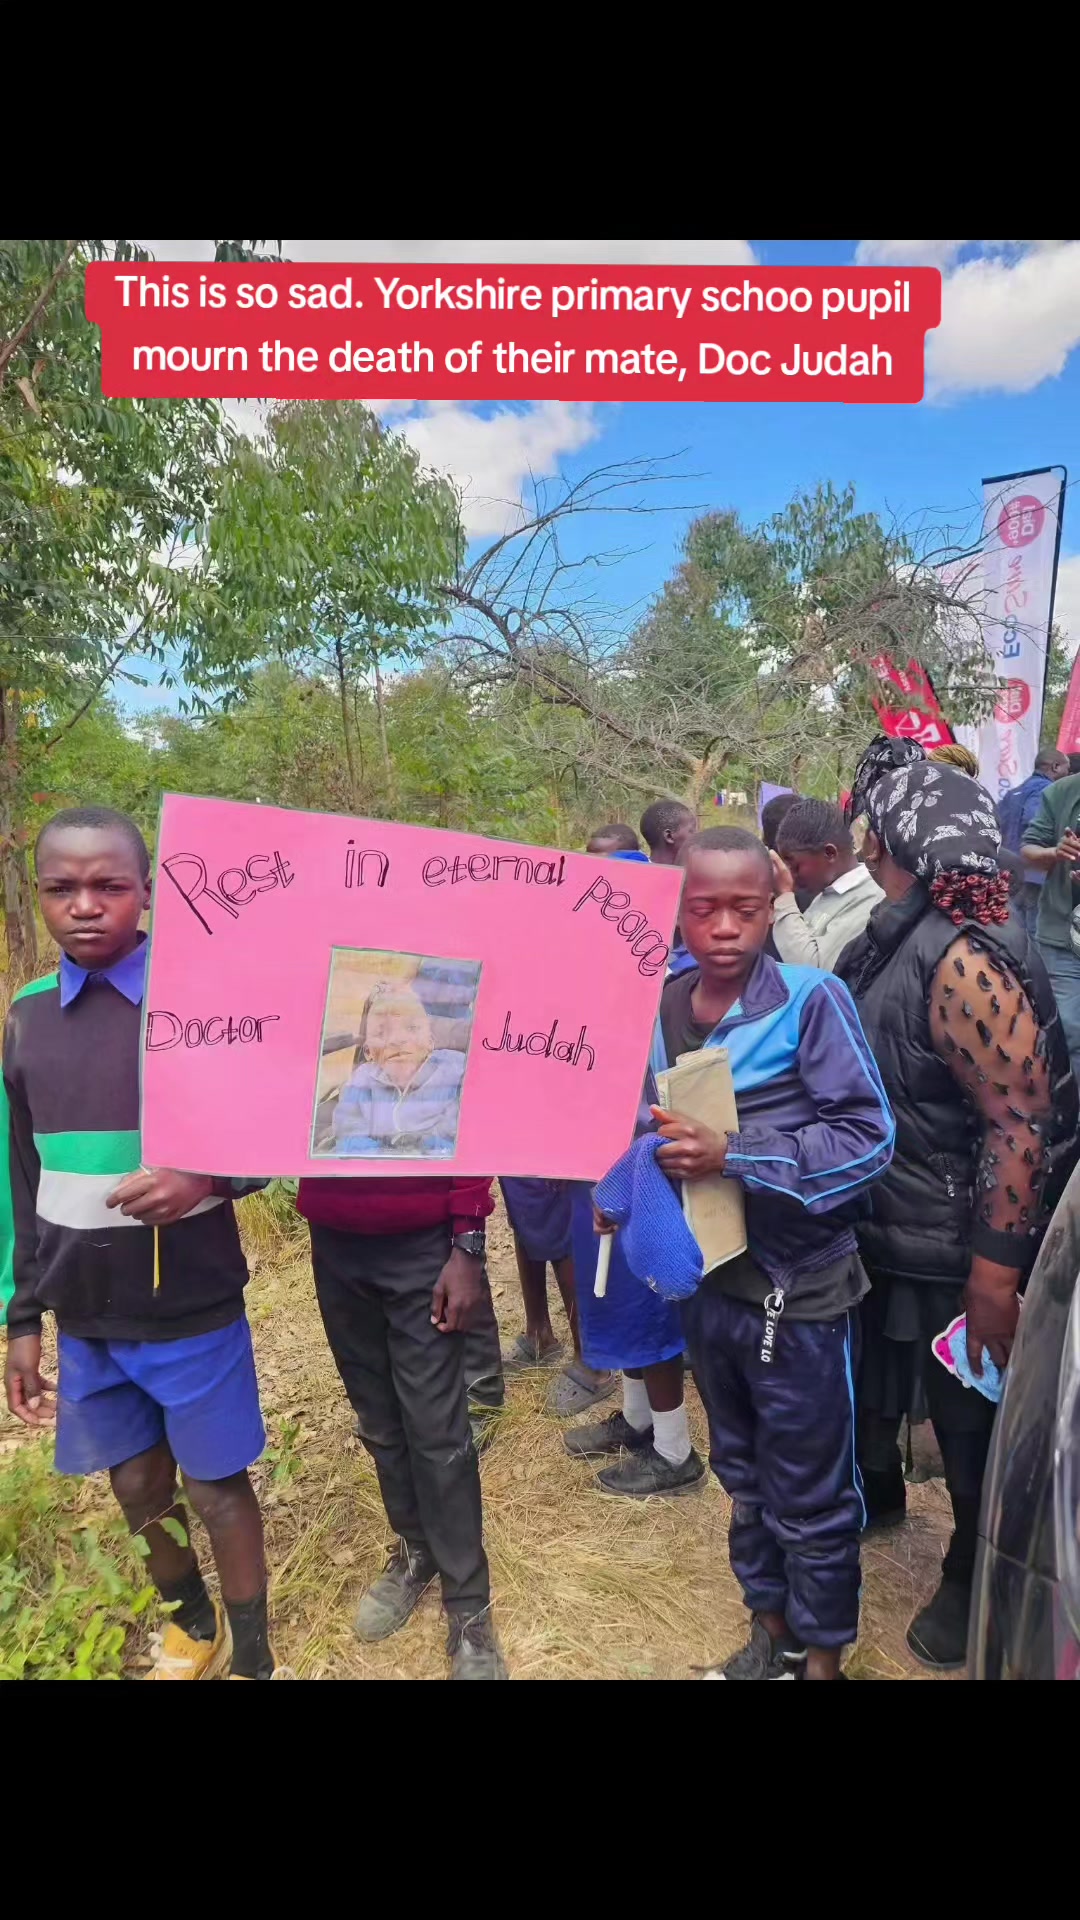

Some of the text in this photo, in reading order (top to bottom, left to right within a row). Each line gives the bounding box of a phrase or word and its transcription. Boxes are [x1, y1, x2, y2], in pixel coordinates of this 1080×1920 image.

[162, 839, 670, 977] Rest in eternal peace
[145, 1010, 281, 1052] Doctor
[482, 1011, 596, 1071] Judah
[763, 1320, 775, 1348] LOVE
